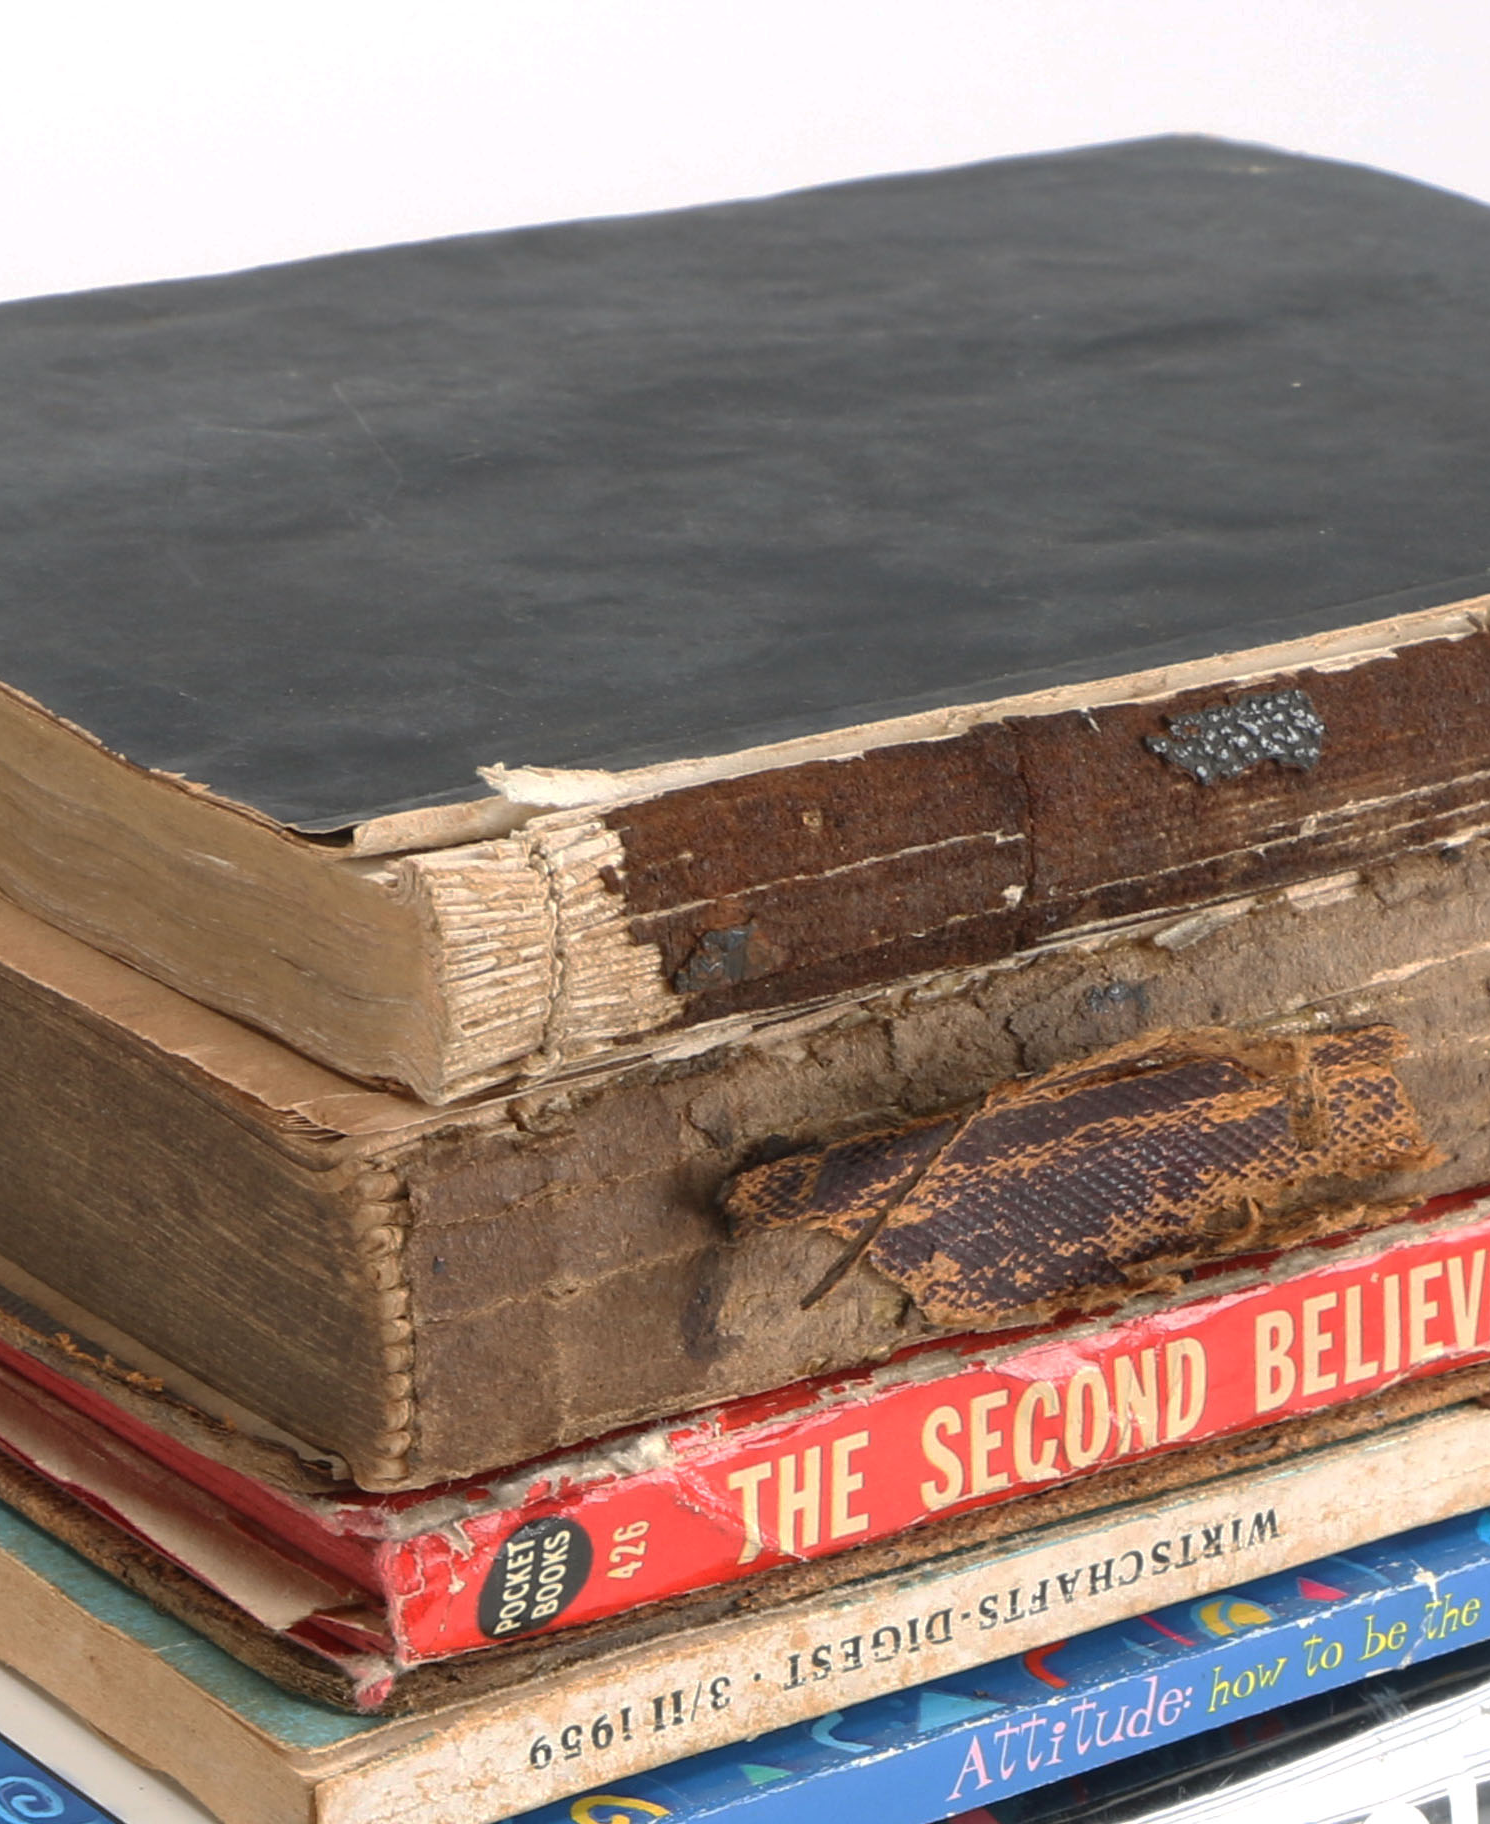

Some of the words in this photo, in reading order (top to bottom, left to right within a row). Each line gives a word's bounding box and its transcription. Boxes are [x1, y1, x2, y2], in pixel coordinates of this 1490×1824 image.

[727, 1432, 870, 1565] THE
[920, 1336, 1206, 1510] SECOND
[493, 1538, 537, 1637] POCKET
[533, 1528, 572, 1627] BOOKS
[607, 1519, 651, 1581] 426
[529, 1706, 632, 1770] 1959
[946, 1674, 1193, 1800] Attitude:
[1207, 1657, 1287, 1714] how
[1303, 1636, 1343, 1675] to
[1356, 1616, 1406, 1663] be
[1422, 1585, 1480, 1640] the
